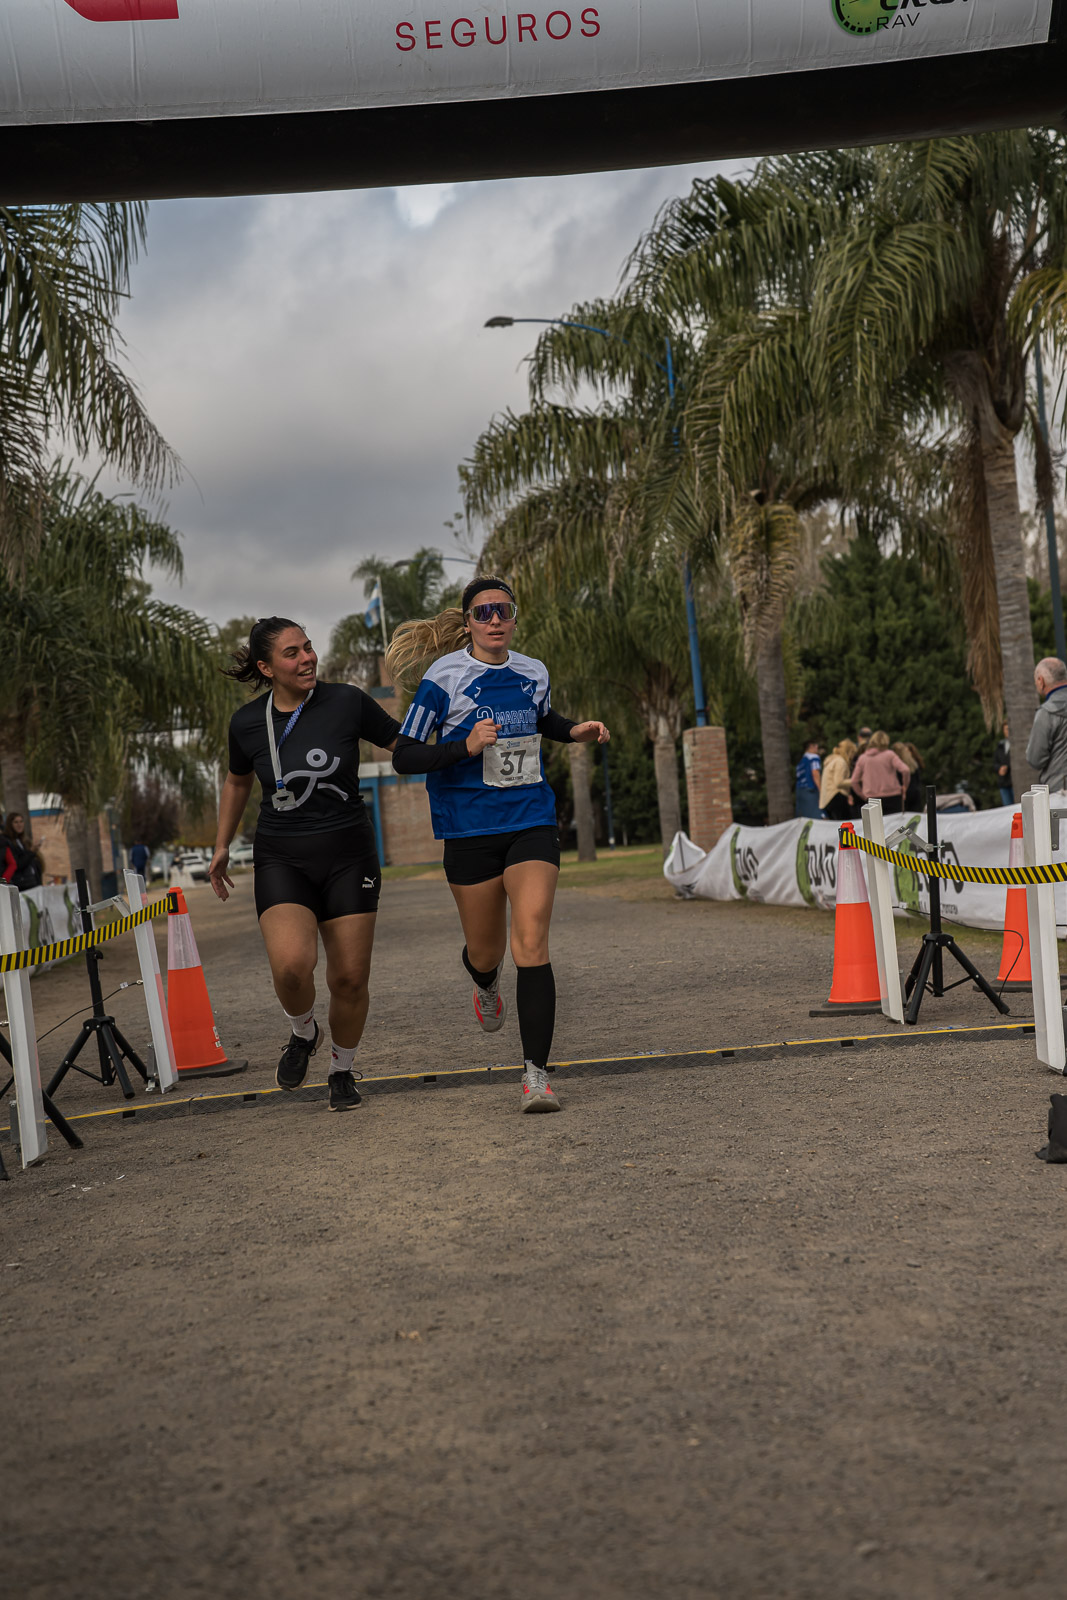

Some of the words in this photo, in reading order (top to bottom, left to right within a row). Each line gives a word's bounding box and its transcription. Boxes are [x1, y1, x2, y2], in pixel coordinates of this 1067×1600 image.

[395, 8, 600, 51] SEGUROS
[876, 12, 920, 30] RAV
[500, 749, 526, 775] 37
